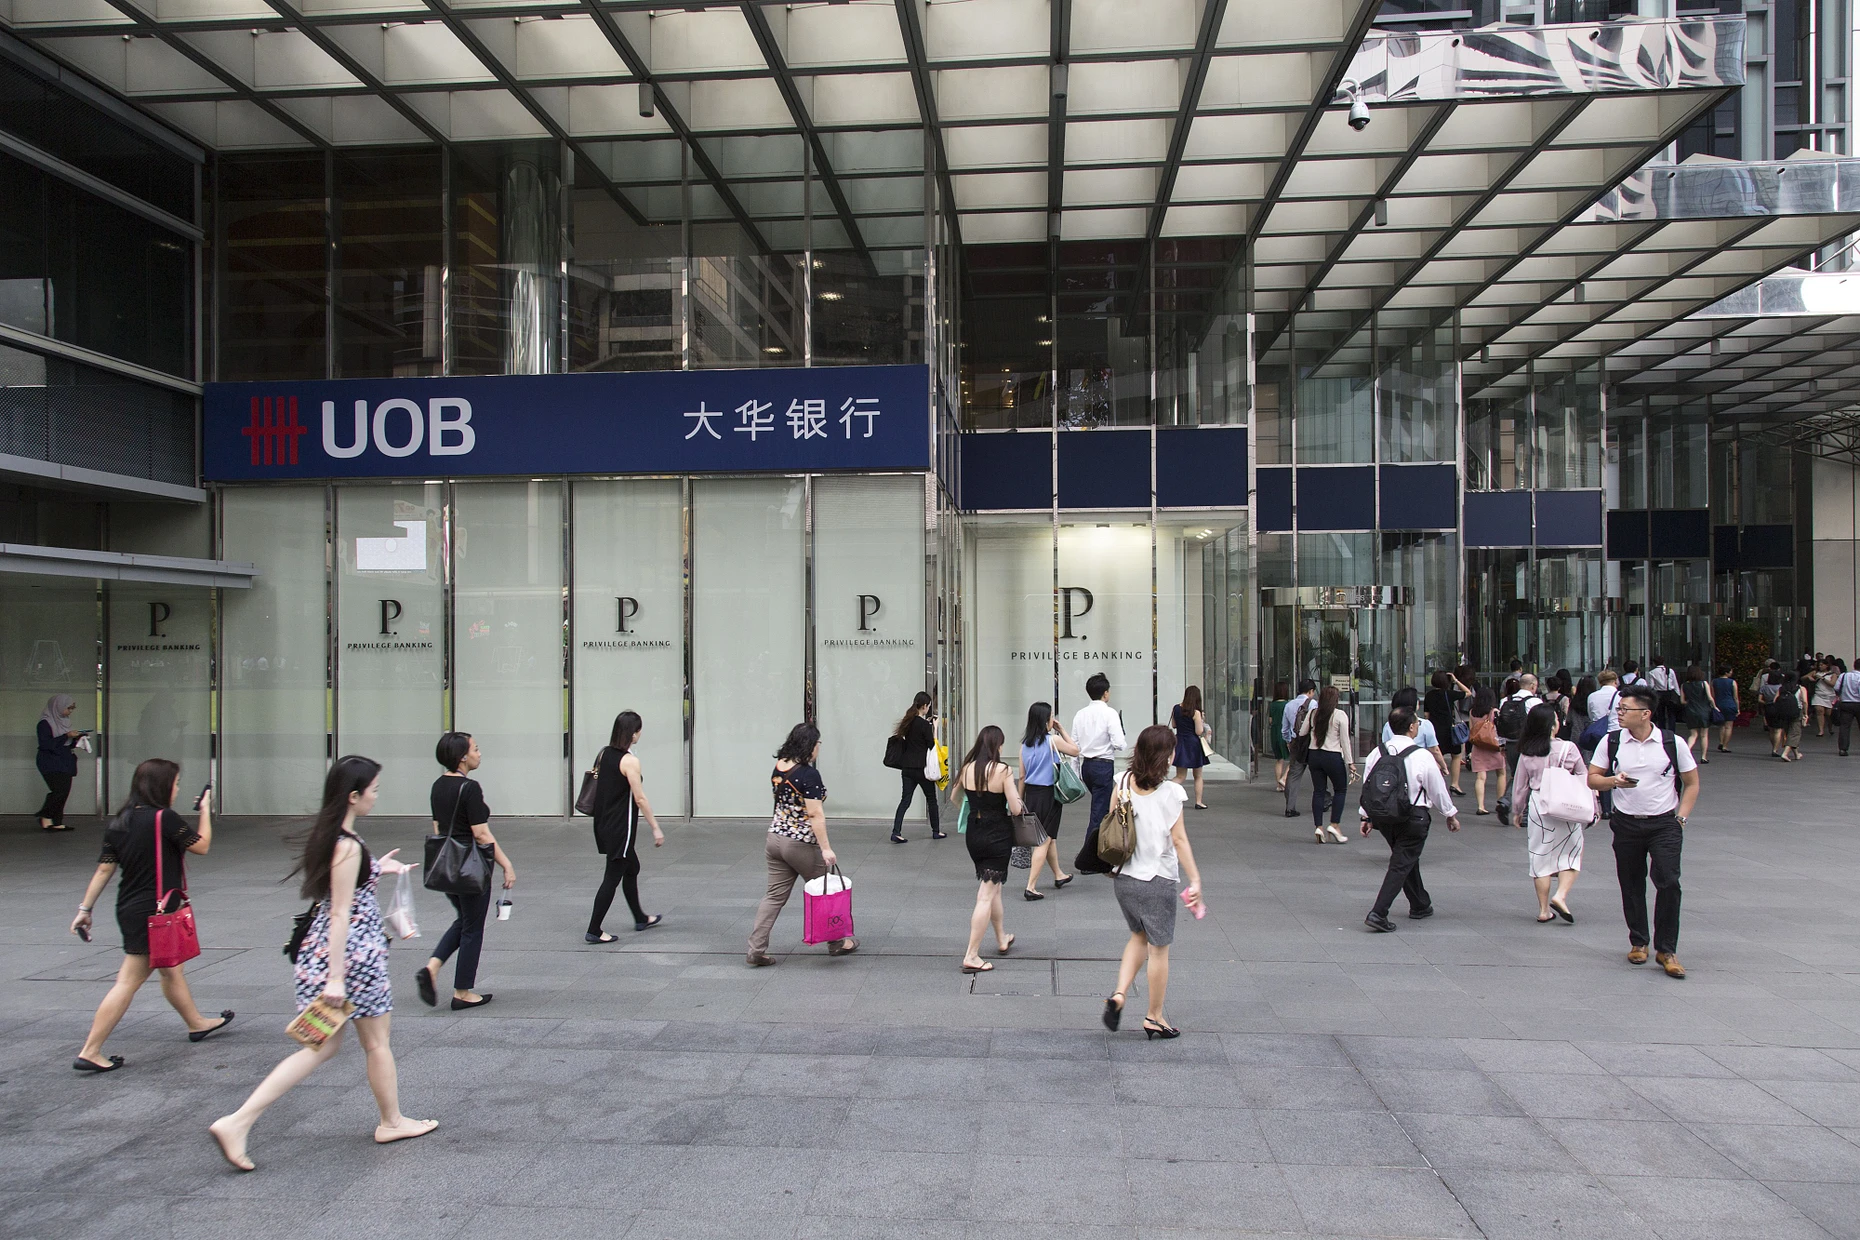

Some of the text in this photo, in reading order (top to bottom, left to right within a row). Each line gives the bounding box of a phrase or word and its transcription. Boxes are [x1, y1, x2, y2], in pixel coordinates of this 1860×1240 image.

[322, 397, 476, 459] UOB
[683, 396, 881, 441] 大华银行
[1083, 651, 1143, 660] BANKING
